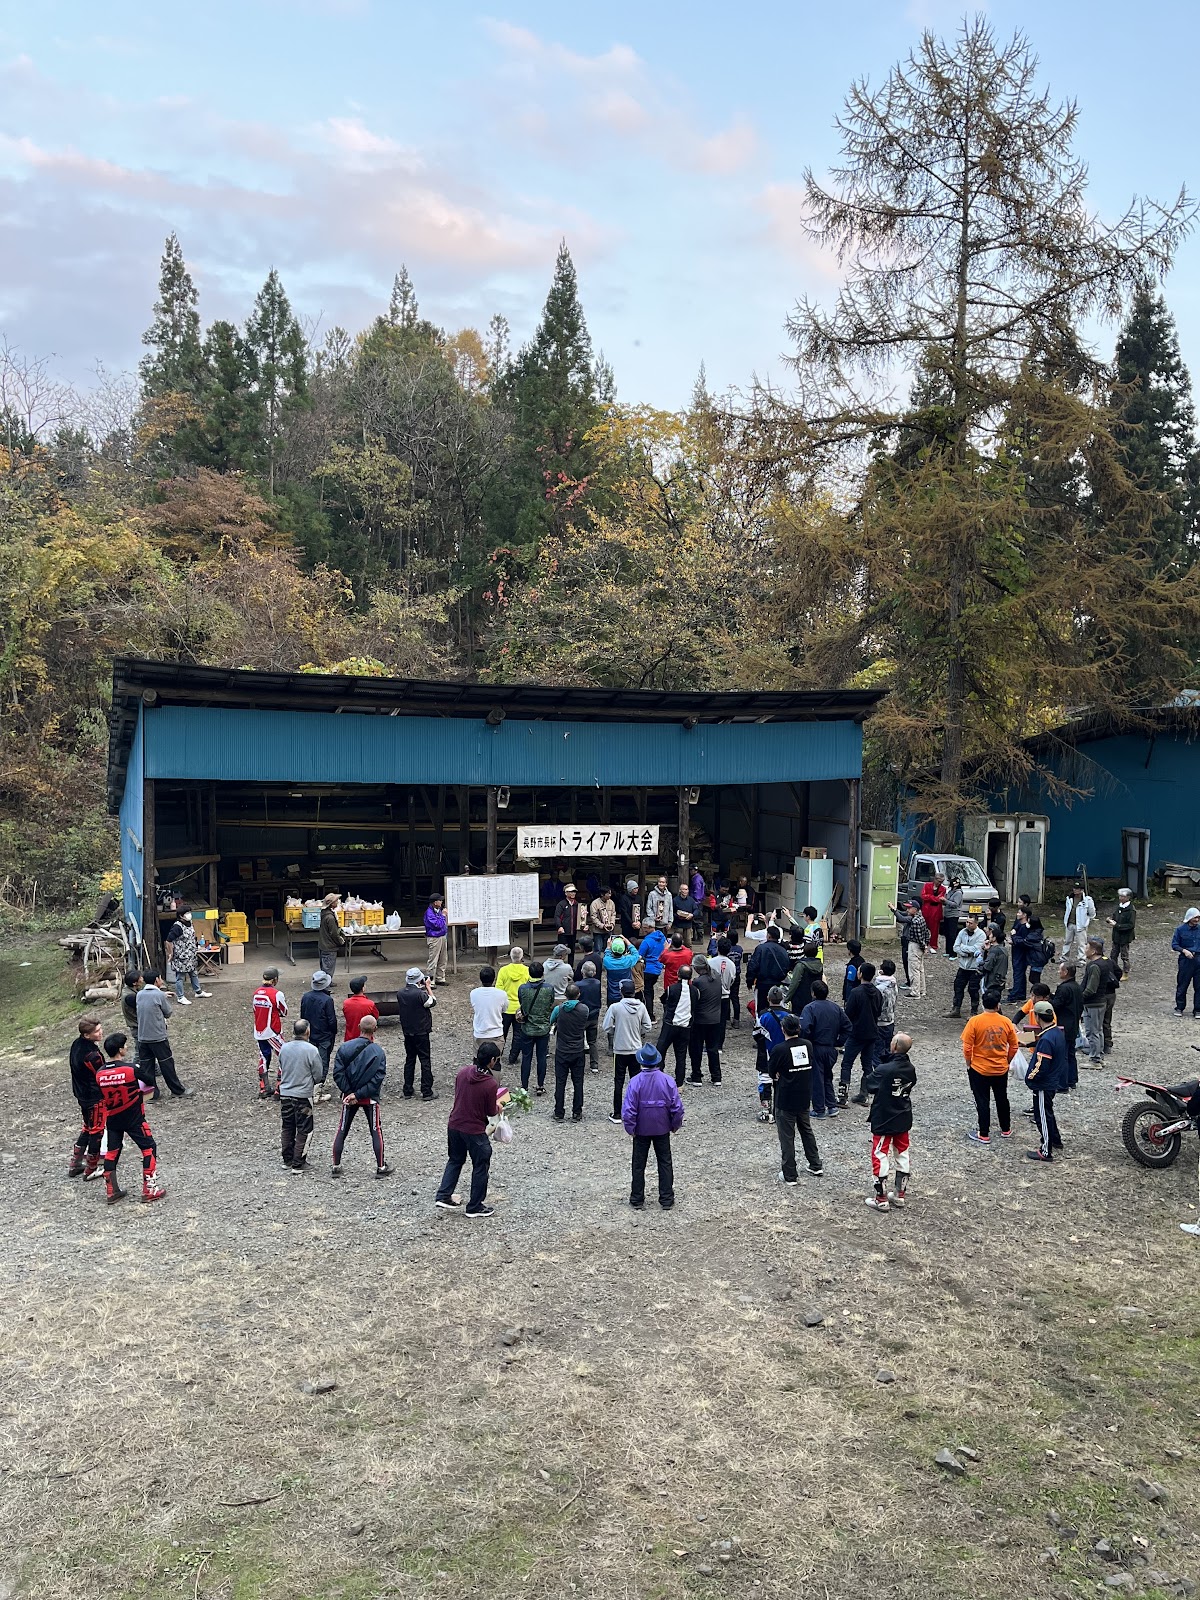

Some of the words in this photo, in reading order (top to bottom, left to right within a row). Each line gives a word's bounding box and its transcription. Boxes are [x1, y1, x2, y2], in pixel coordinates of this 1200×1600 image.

[523, 829, 653, 852] 長野市長杯トライアル大会
